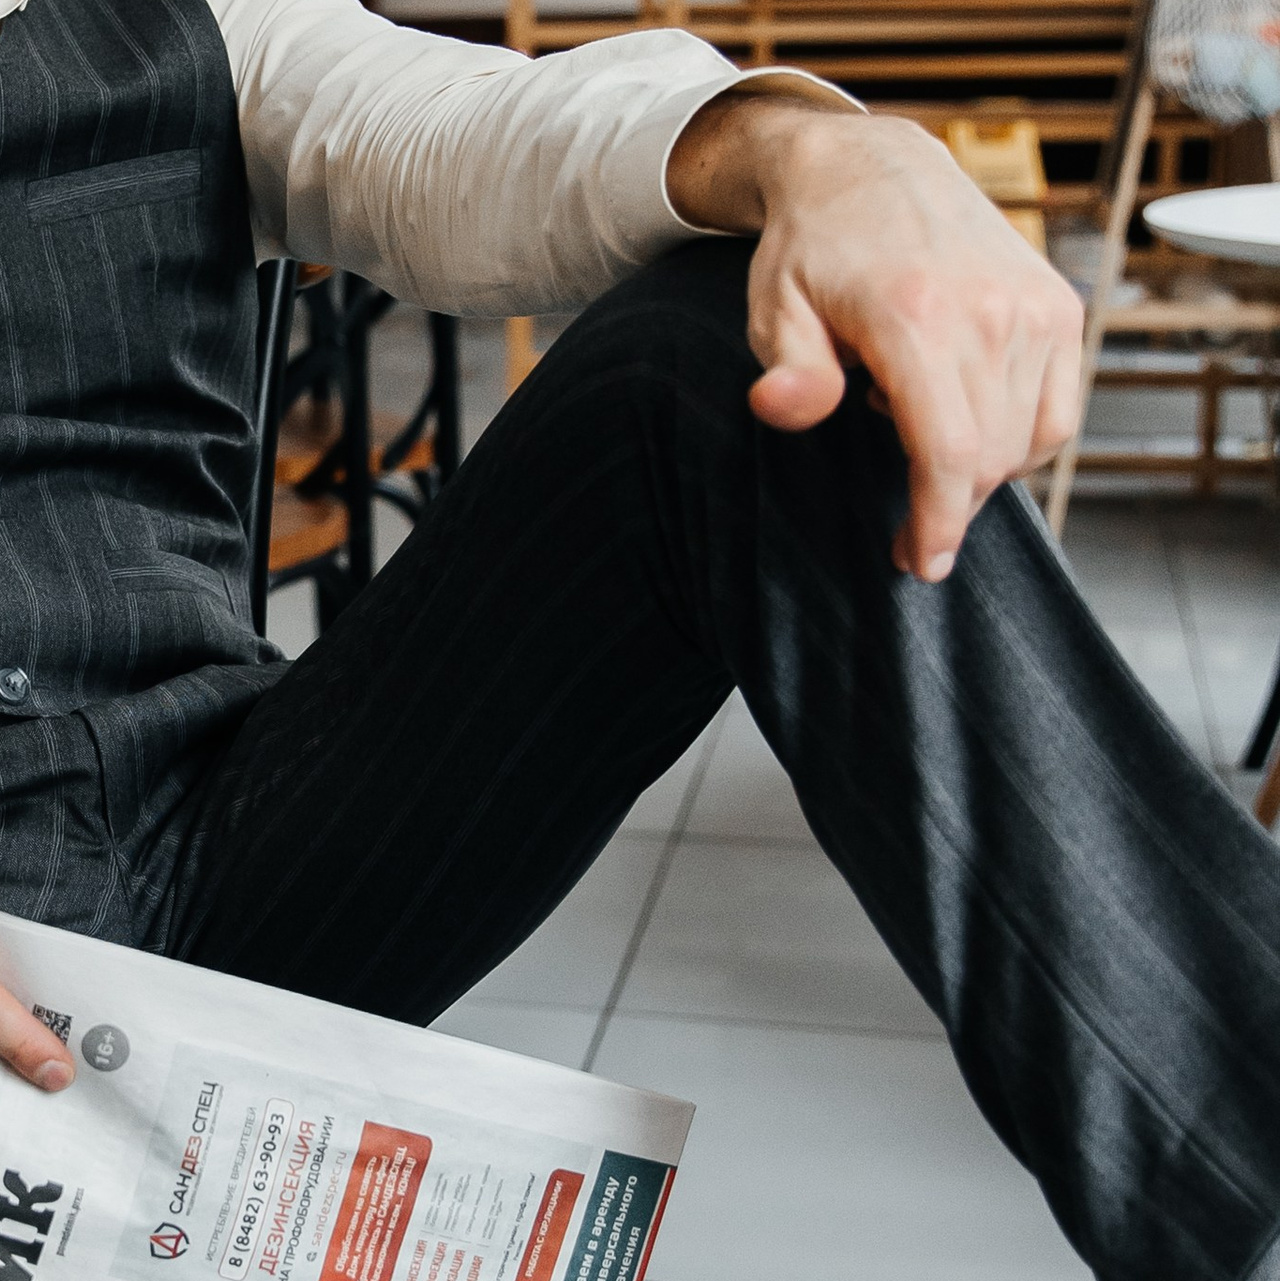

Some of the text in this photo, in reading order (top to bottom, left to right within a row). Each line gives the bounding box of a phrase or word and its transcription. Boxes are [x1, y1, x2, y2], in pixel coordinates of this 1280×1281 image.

[94, 1031, 115, 1065] 16+
[205, 1106, 257, 1262] ИСТРЕБЛЕНИЕ ВРЕДИТЕЛЕЙ
[228, 1113, 285, 1268] 8 (8482) 63-90-93
[258, 1120, 316, 1276] ДЕЗИНСЕКЦИЯ
[282, 1115, 335, 1266] ПРОФОБОРУДОВАНИИ
[311, 1149, 351, 1247] sandezspec.ru
[369, 1185, 381, 1206] или
[375, 1155, 391, 1185] офис!
[396, 1156, 417, 1197] КОНЕЦ!
[591, 1176, 620, 1237] аренду
[334, 1156, 378, 1273] Обработаем на совесть
[376, 1218, 384, 1227] в
[524, 1241, 543, 1278] РАБОТА
[536, 1235, 545, 1244] С
[587, 1239, 599, 1252] в
